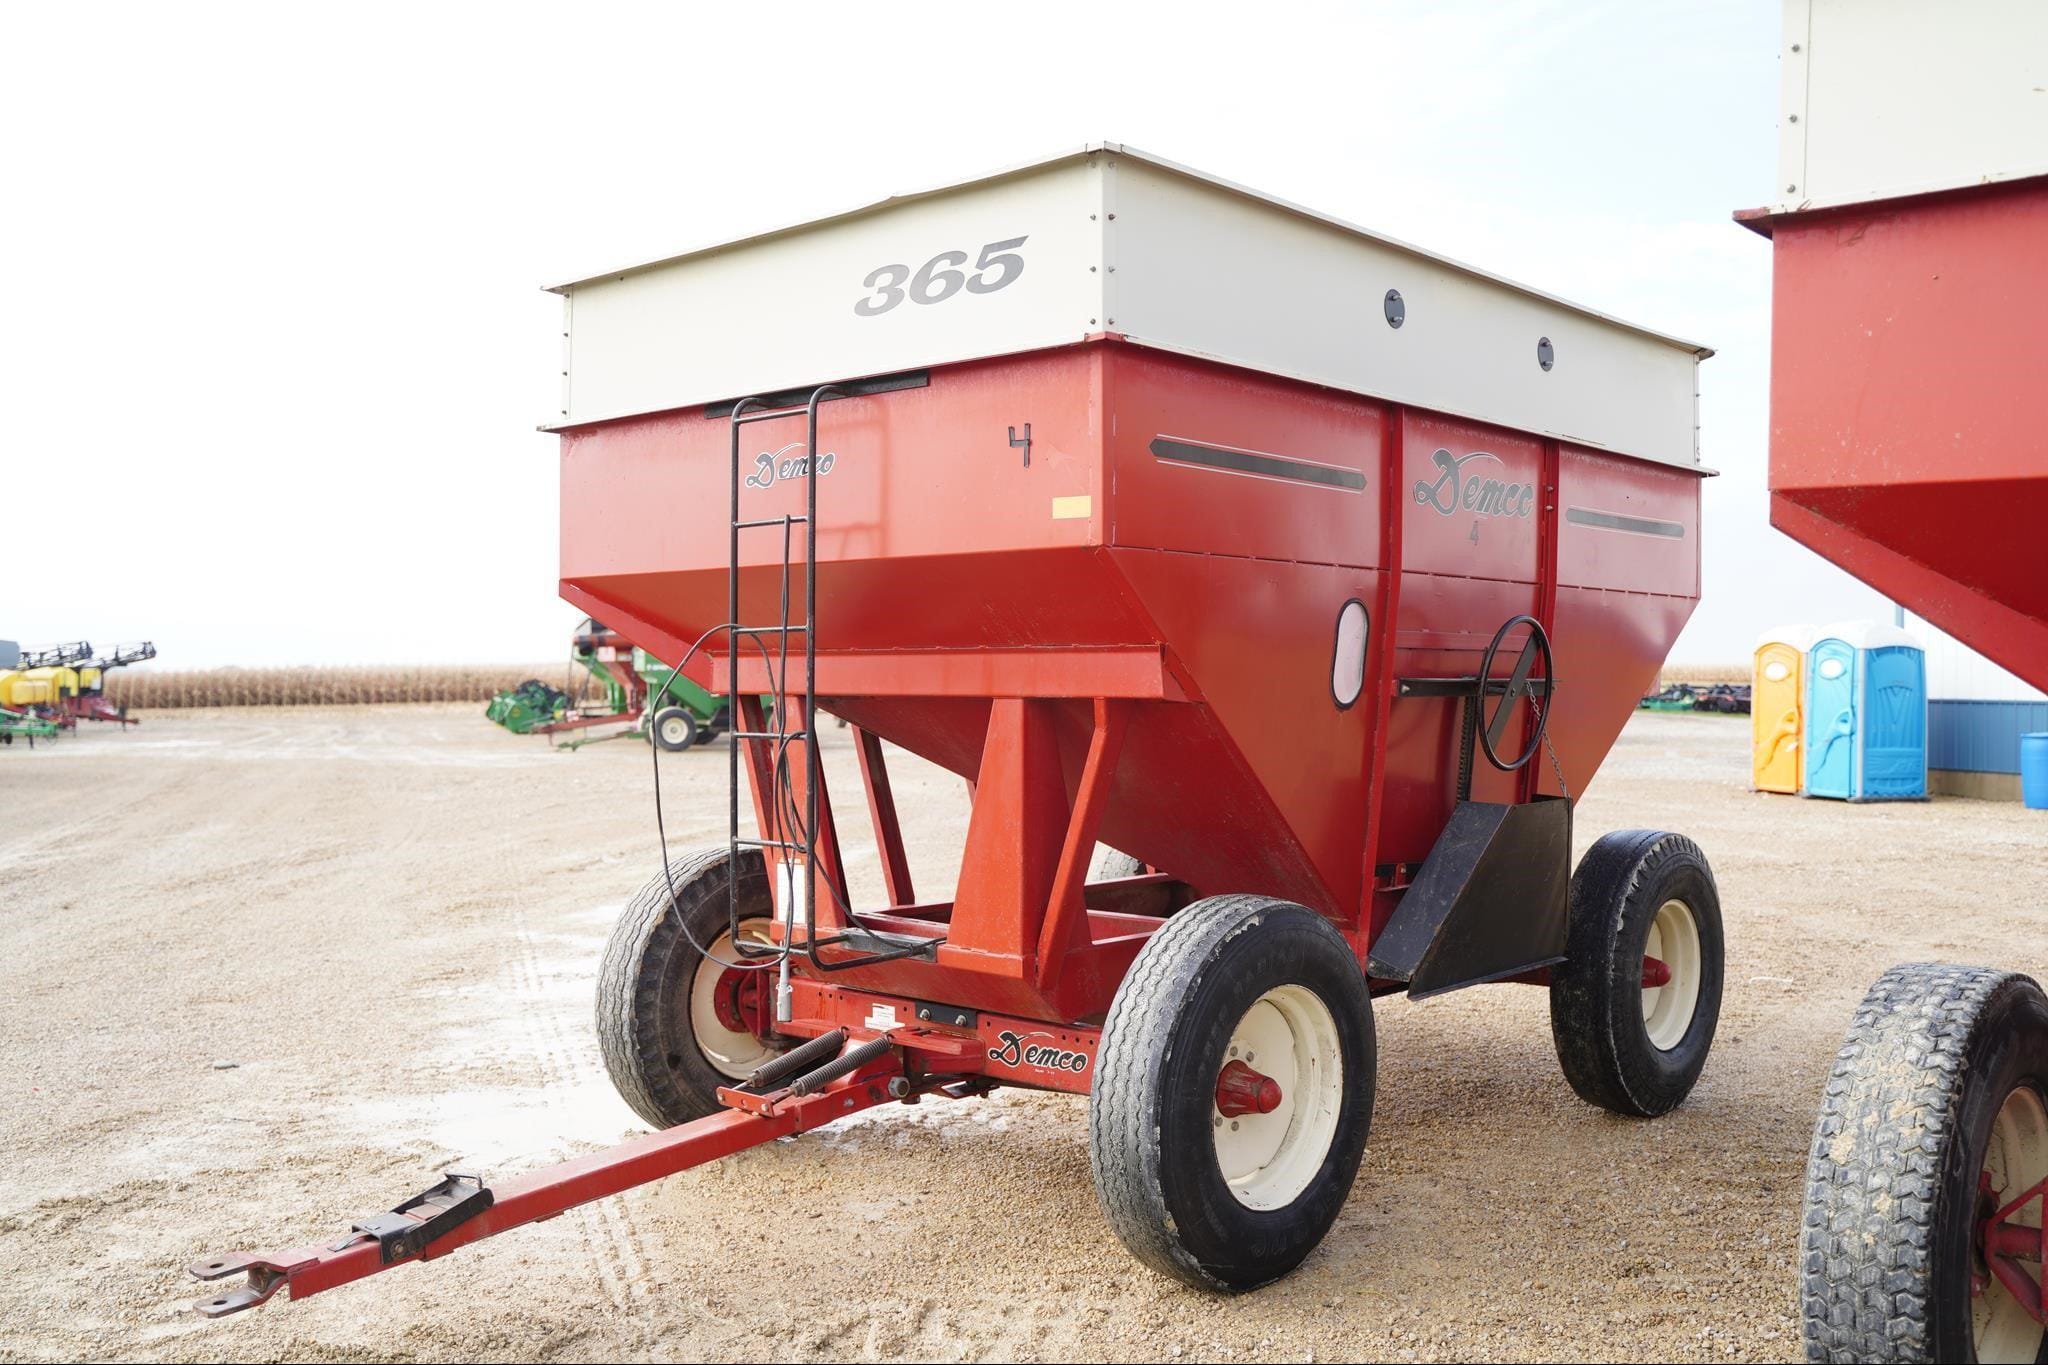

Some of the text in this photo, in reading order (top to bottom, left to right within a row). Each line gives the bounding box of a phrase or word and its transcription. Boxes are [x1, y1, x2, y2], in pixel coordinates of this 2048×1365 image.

[854, 235, 1029, 316] 365
[1008, 423, 1031, 468] 4
[988, 1030, 1088, 1073] Demco
